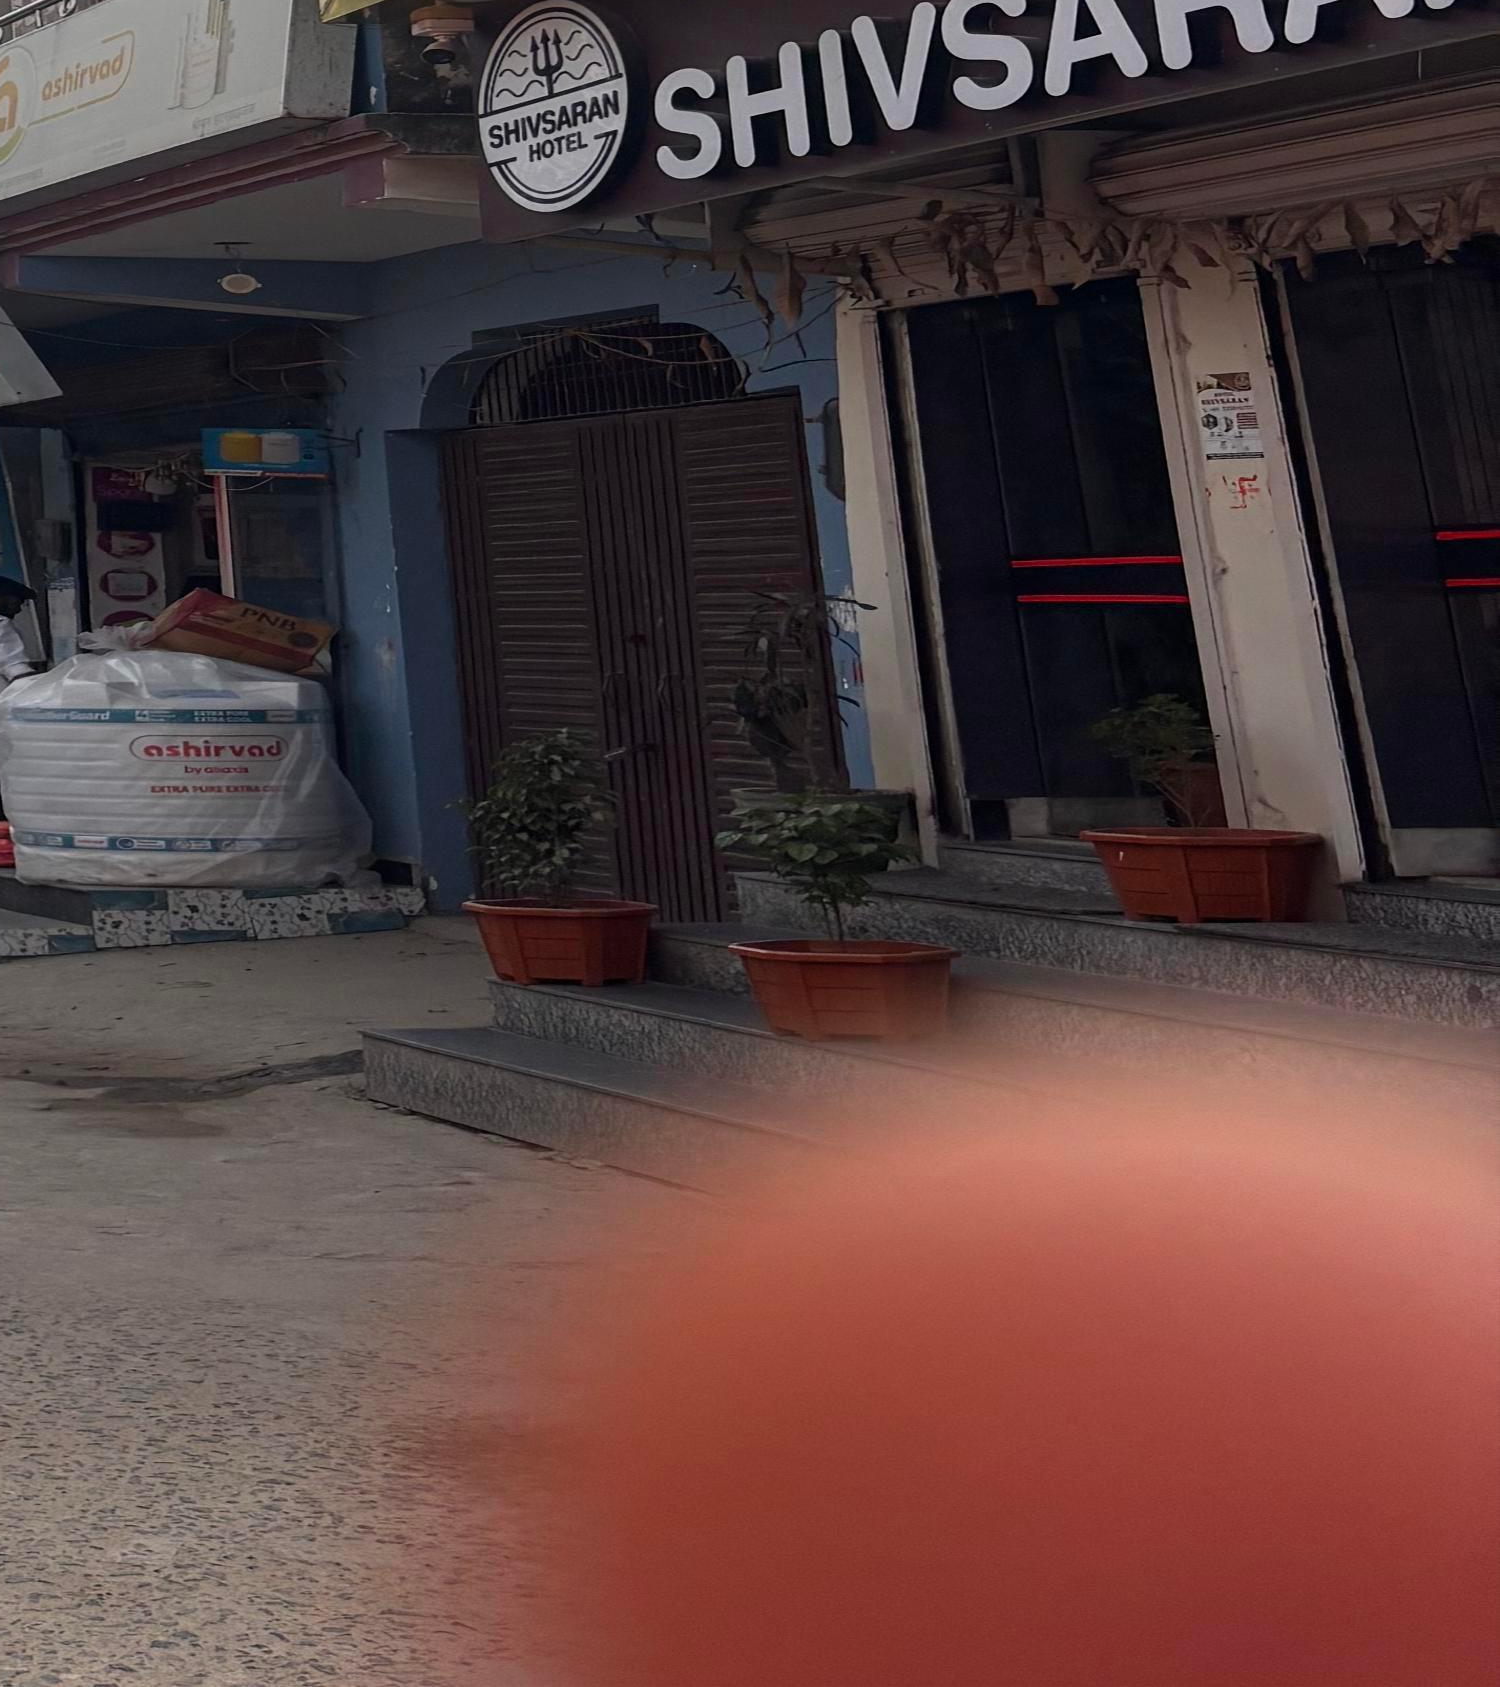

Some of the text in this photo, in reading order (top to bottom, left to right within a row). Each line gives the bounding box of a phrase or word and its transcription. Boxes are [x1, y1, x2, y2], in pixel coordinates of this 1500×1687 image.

[42, 47, 125, 101] ashirvad
[488, 90, 620, 149] SHIVSARAN
[529, 131, 588, 163] HOTEL
[242, 607, 297, 632] PNB
[143, 739, 282, 758] ashirvad
[184, 765, 201, 775] by
